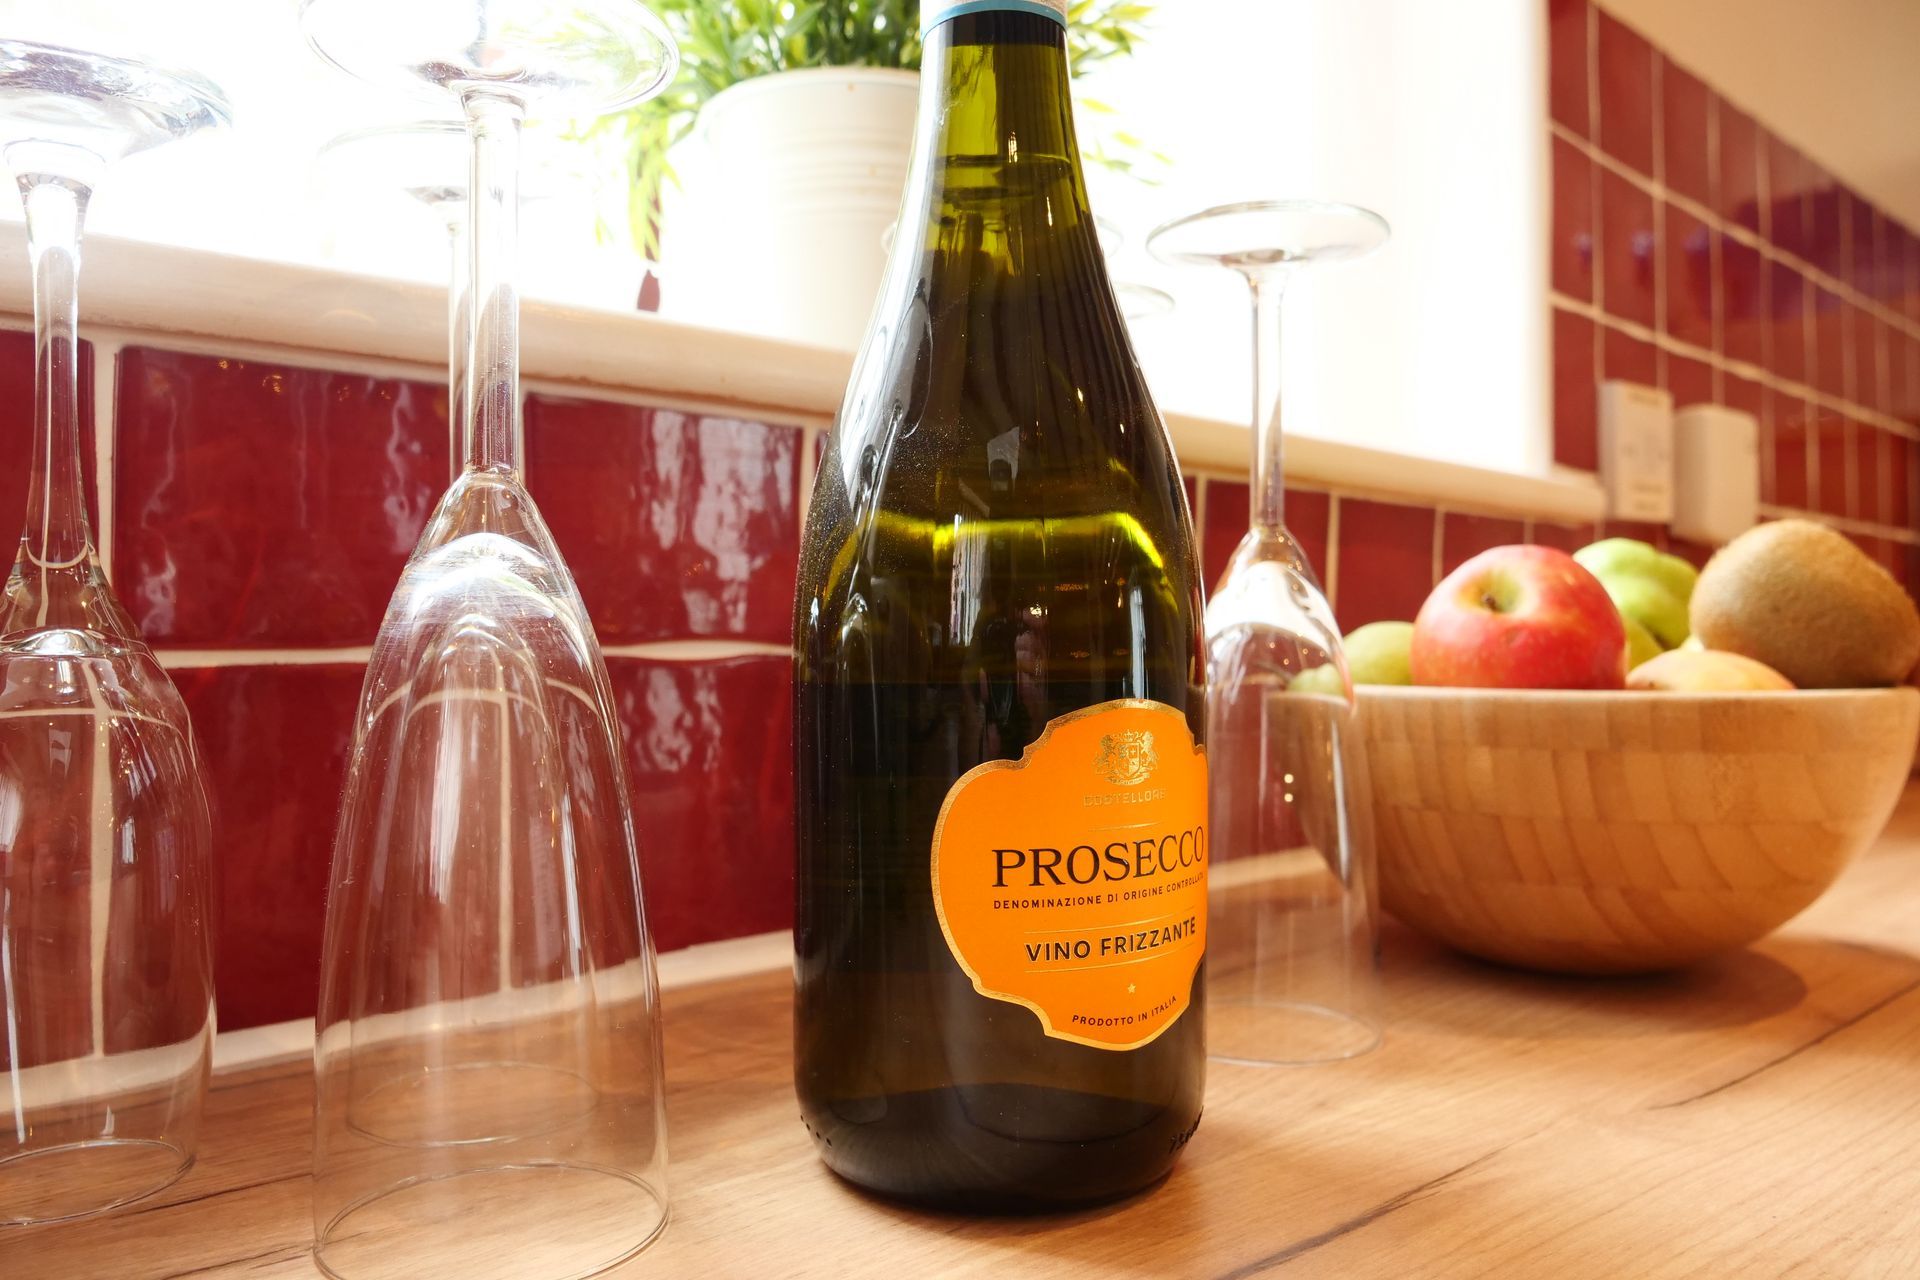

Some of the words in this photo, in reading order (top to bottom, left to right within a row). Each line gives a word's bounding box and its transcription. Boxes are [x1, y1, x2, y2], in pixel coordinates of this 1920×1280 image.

[991, 826, 1204, 887] PROSECCO
[994, 894, 1102, 909] DENOMINAZIONE
[1107, 893, 1119, 903] DI
[1123, 886, 1163, 900] ORIGINE
[1025, 940, 1091, 962] VINO
[1101, 916, 1196, 956] FRIZZANTE
[1072, 1014, 1134, 1027] PRODOTTO
[1138, 1014, 1148, 1022] IN
[1151, 995, 1177, 1016] ITALIA
